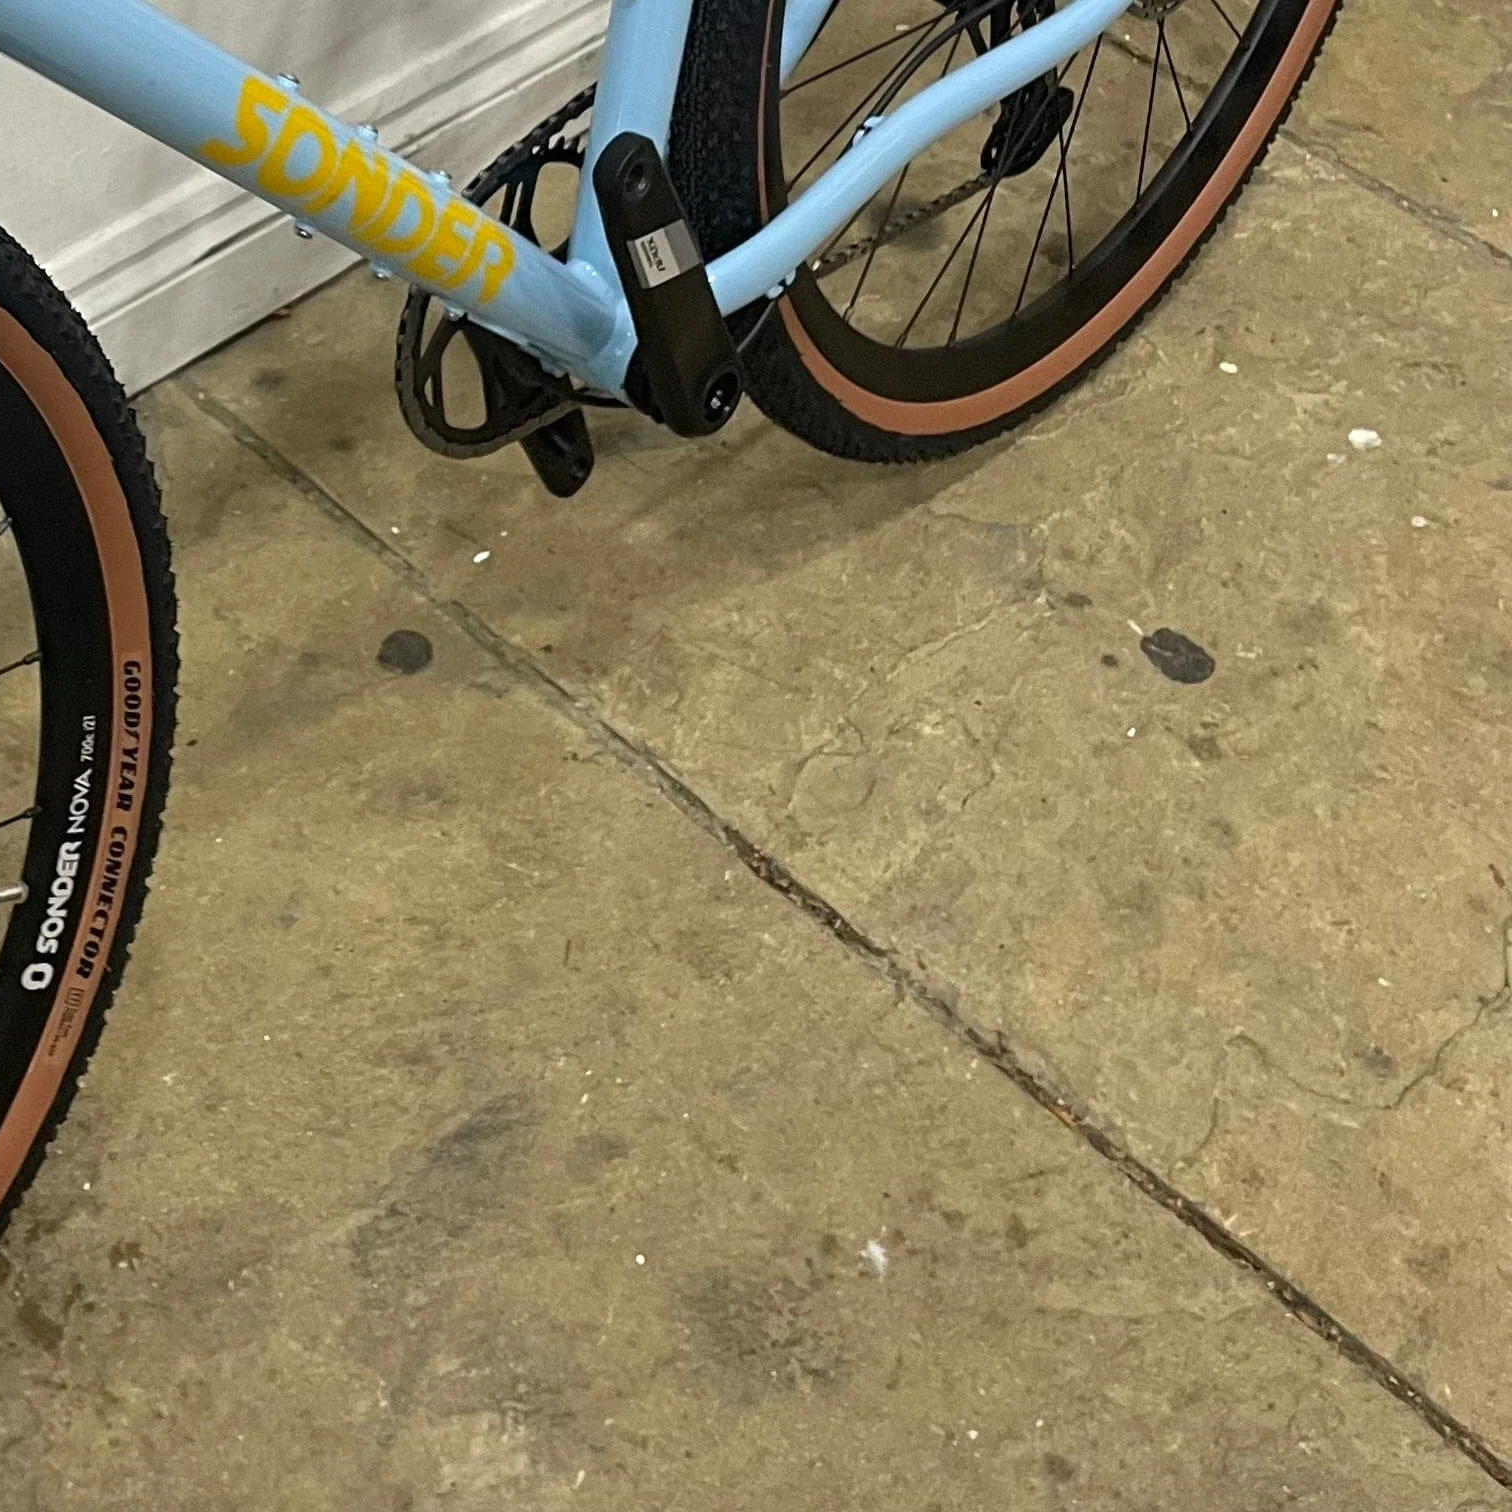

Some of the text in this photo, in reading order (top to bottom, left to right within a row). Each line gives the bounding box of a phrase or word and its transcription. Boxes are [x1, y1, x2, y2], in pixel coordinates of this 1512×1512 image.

[198, 74, 517, 305] SONDER
[35, 840, 83, 954] SONDER
[66, 768, 93, 834] NOVA
[76, 825, 128, 979] CONNECTOR
